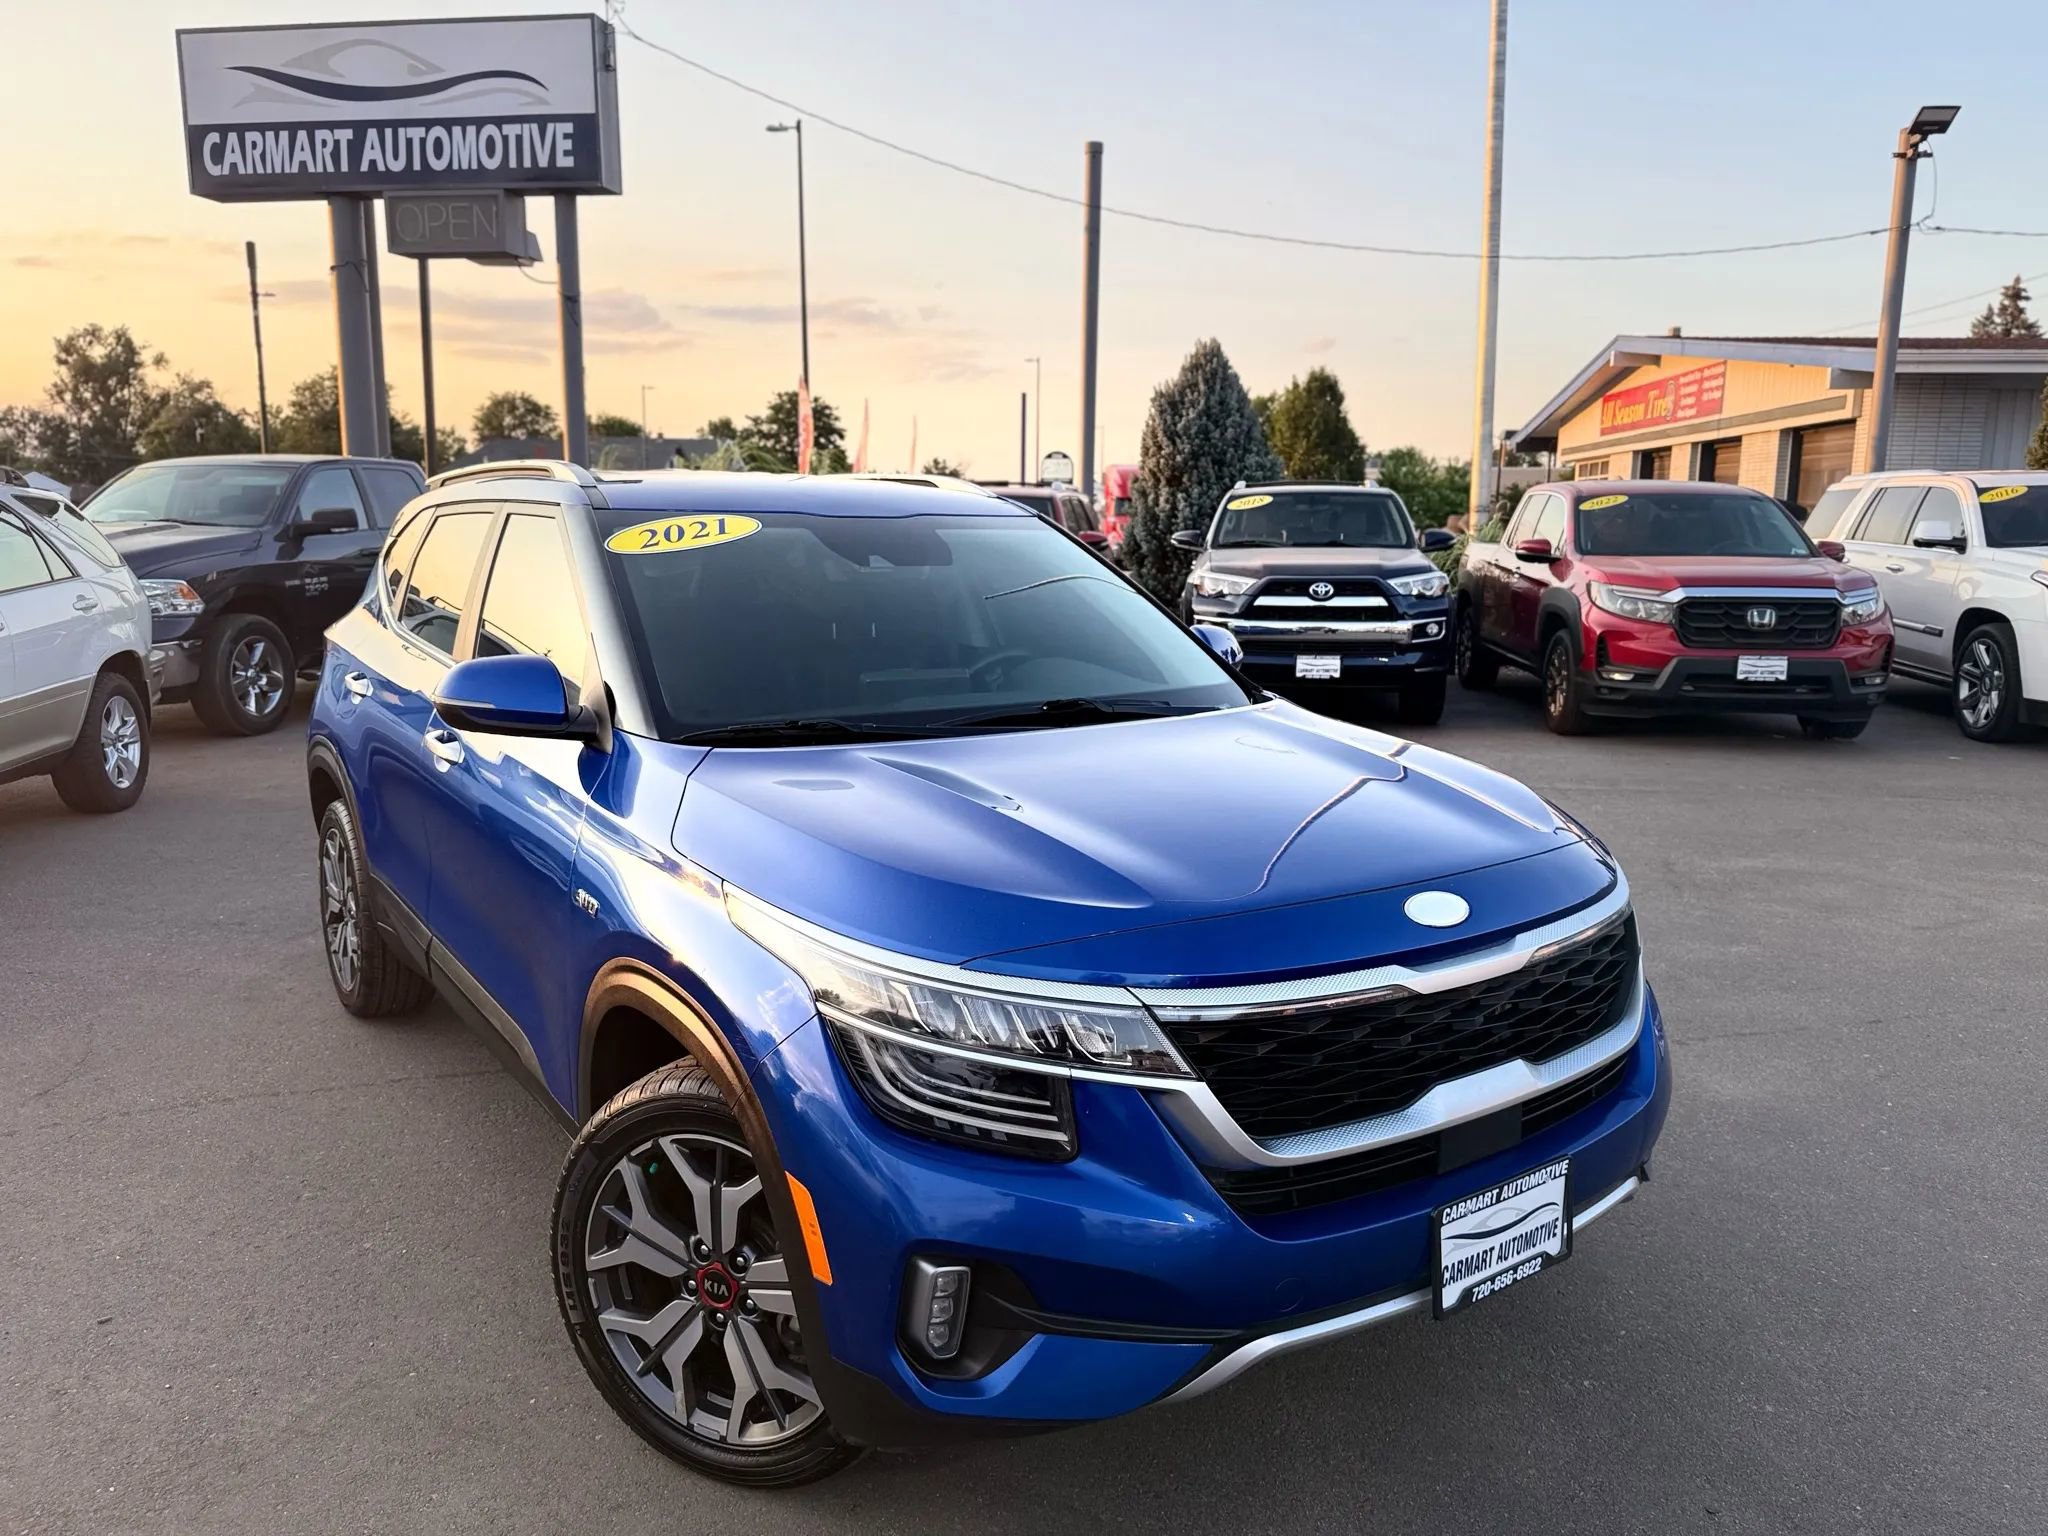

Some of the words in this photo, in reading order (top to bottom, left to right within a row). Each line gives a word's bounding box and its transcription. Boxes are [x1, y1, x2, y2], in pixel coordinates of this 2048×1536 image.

[202, 128, 354, 177] CARMART
[360, 121, 575, 173] AUTOMOTIVE
[395, 202, 497, 242] OPEN
[1987, 486, 2019, 501] 2016
[637, 517, 732, 550] 2021
[1442, 1188, 1500, 1225] CARMART
[1500, 1159, 1570, 1201] AUTOMOTIVE
[1442, 1246, 1496, 1288] CARMART
[1496, 1216, 1560, 1265] AUTOMOTIVE
[704, 1277, 729, 1297] KIA
[1472, 1257, 1543, 1303] 720-656-6922
